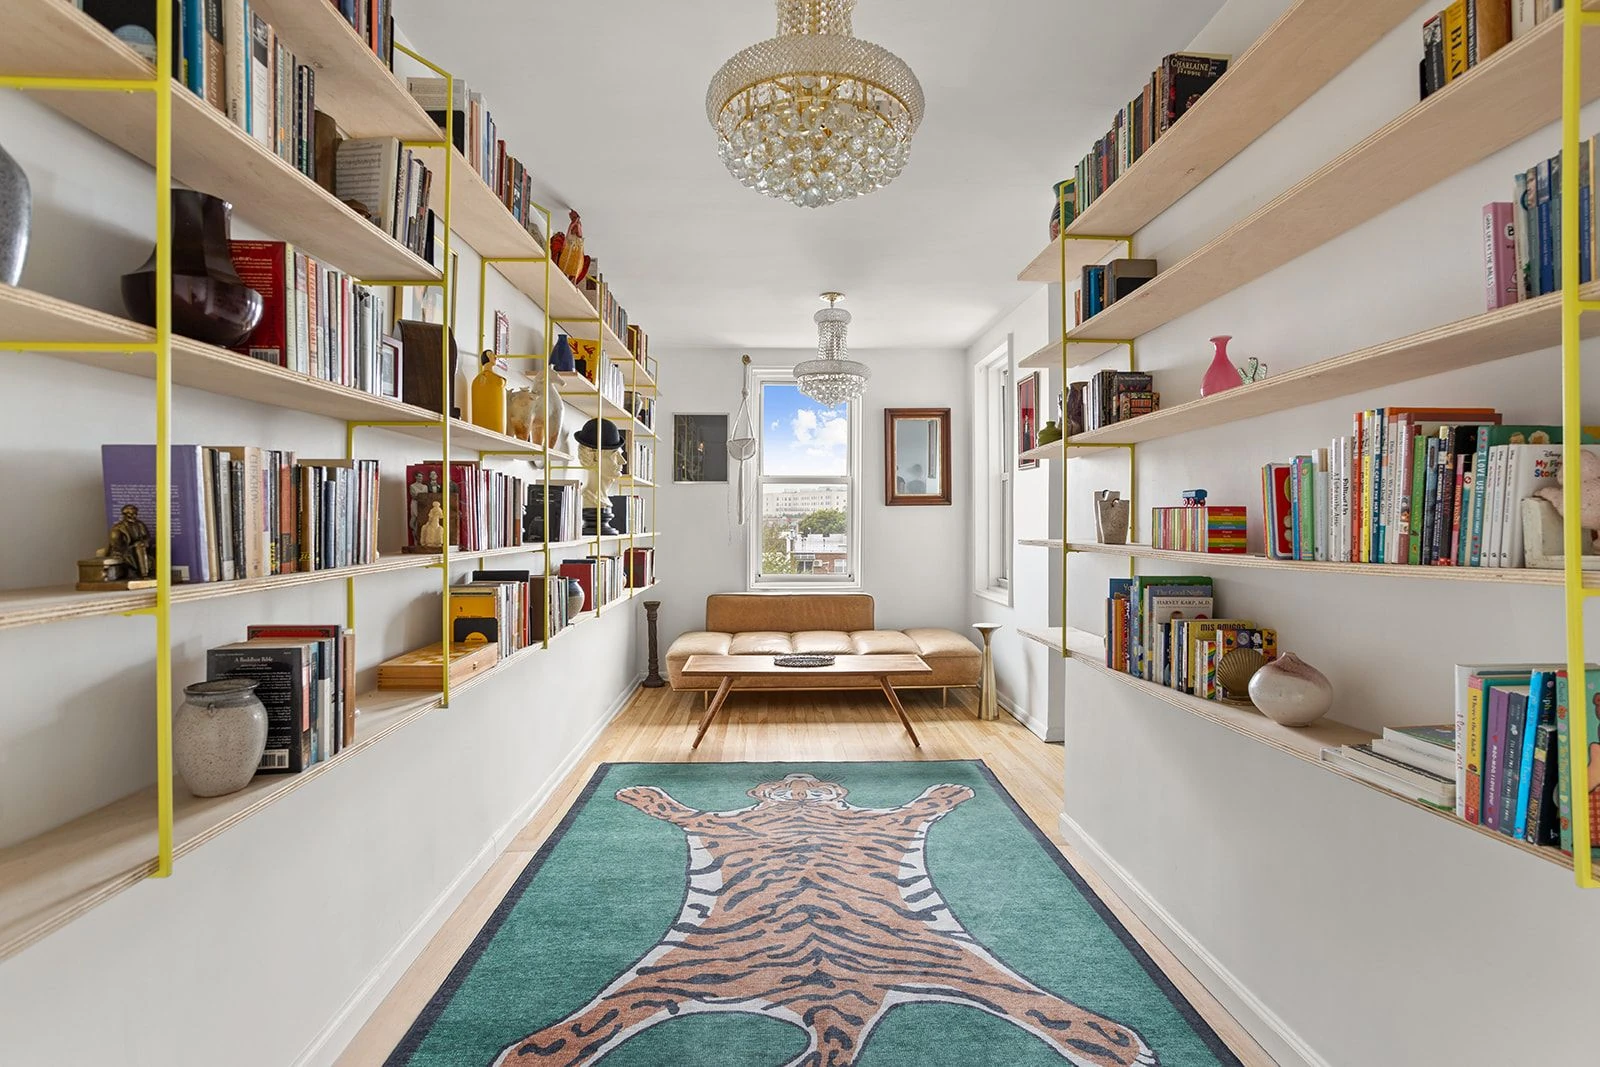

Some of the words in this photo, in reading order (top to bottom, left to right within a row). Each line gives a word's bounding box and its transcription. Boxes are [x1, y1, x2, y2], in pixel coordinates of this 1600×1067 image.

[1170, 57, 1209, 71] CHARLAINE
[1477, 459, 1486, 477] LOVE
[1535, 459, 1548, 469] My
[1549, 459, 1563, 468] Fir
[249, 454, 260, 502] CHEKHOV
[1475, 480, 1484, 494] US!
[1471, 695, 1479, 720] Where's
[1470, 733, 1478, 758] Chick?
[1530, 798, 1540, 818] ANGRY
[1527, 818, 1538, 835] DUCK
